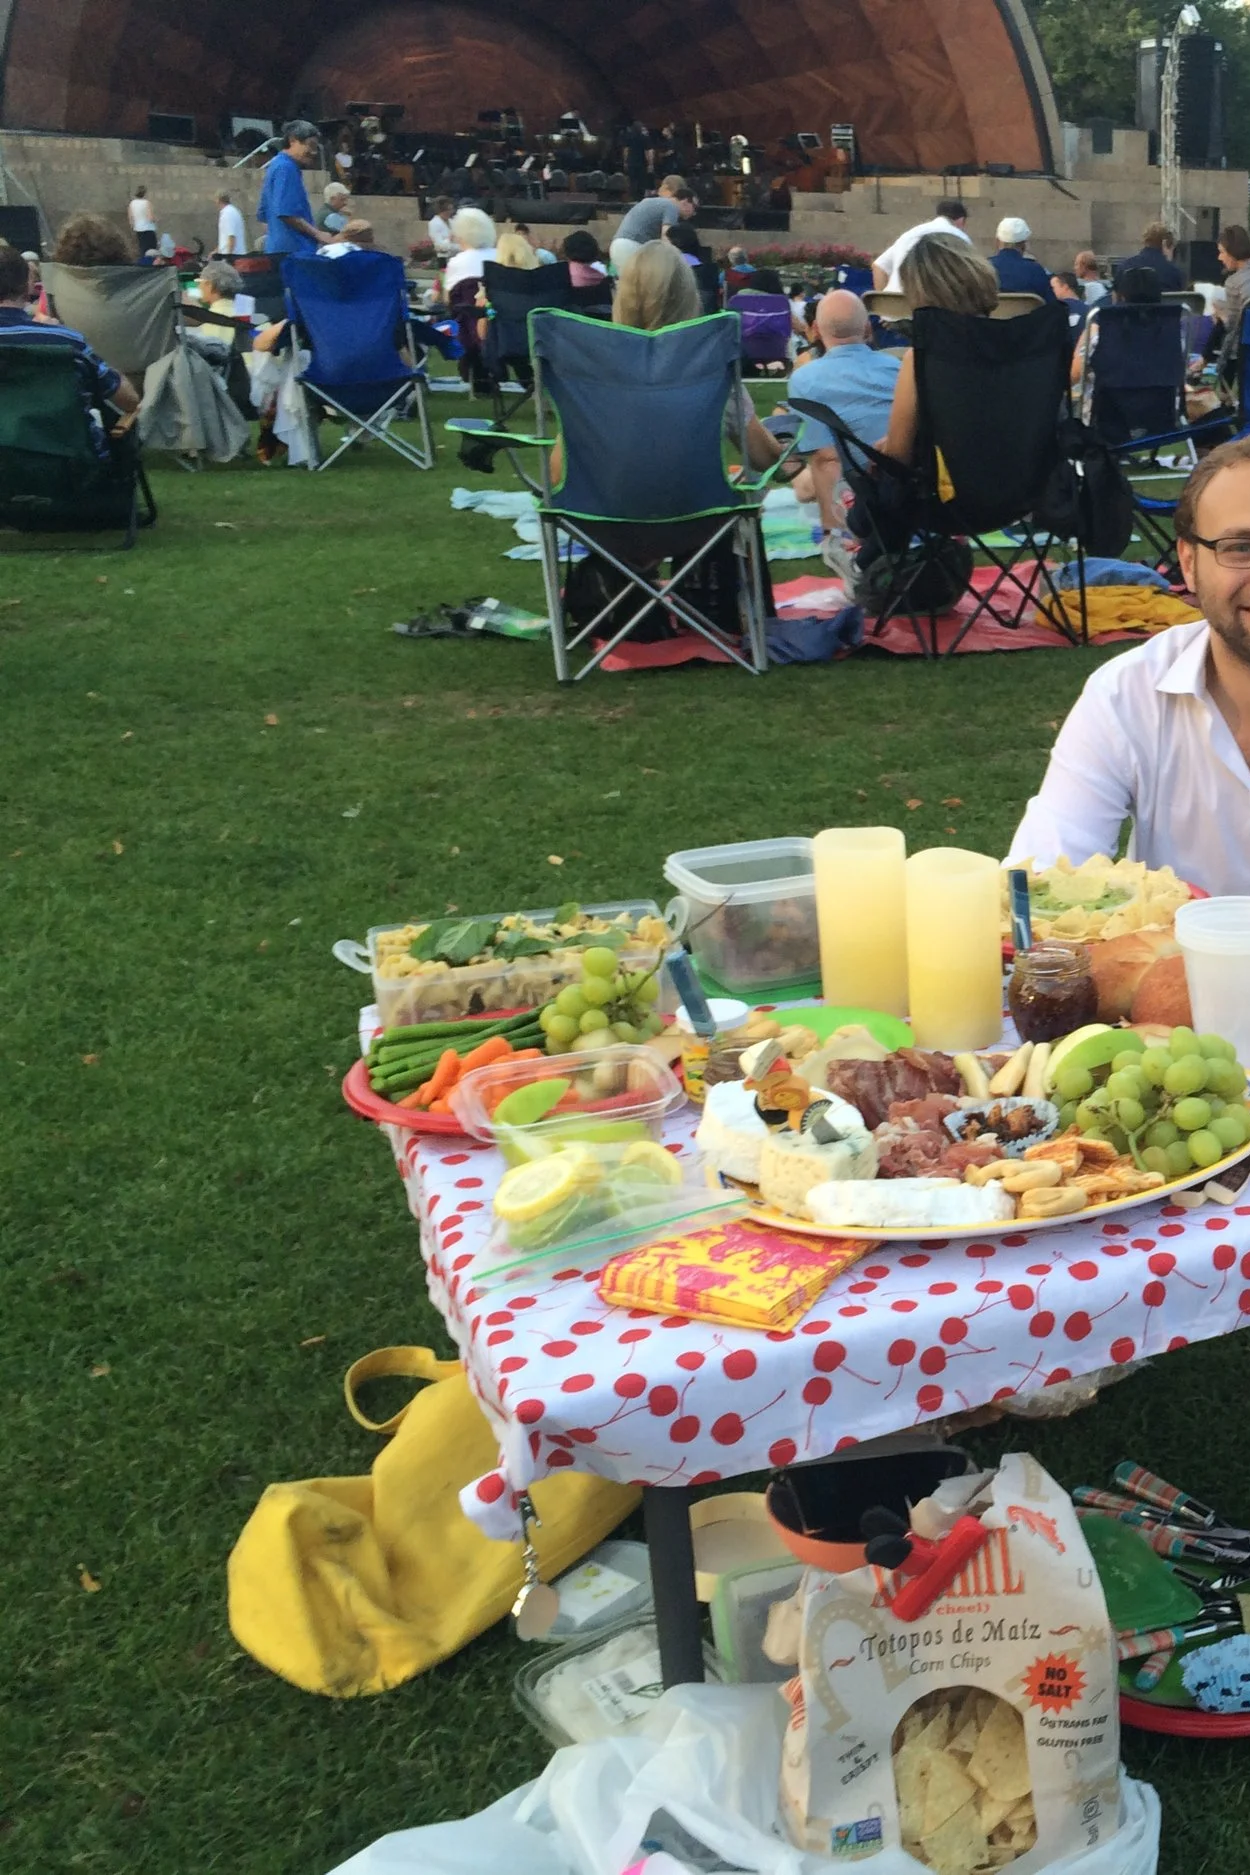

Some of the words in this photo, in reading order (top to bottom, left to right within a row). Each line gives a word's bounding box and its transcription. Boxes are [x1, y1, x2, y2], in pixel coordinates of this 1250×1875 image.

[861, 1628, 944, 1661] Totopos
[952, 1619, 973, 1644] de
[981, 1618, 1043, 1643] Maíz
[909, 1658, 945, 1676] Corn
[950, 1652, 992, 1674] Chips
[1045, 1667, 1068, 1681] NO
[1037, 1683, 1073, 1698] SALT
[1036, 1736, 1079, 1748] GLUTEN
[1081, 1734, 1105, 1747] FREE
